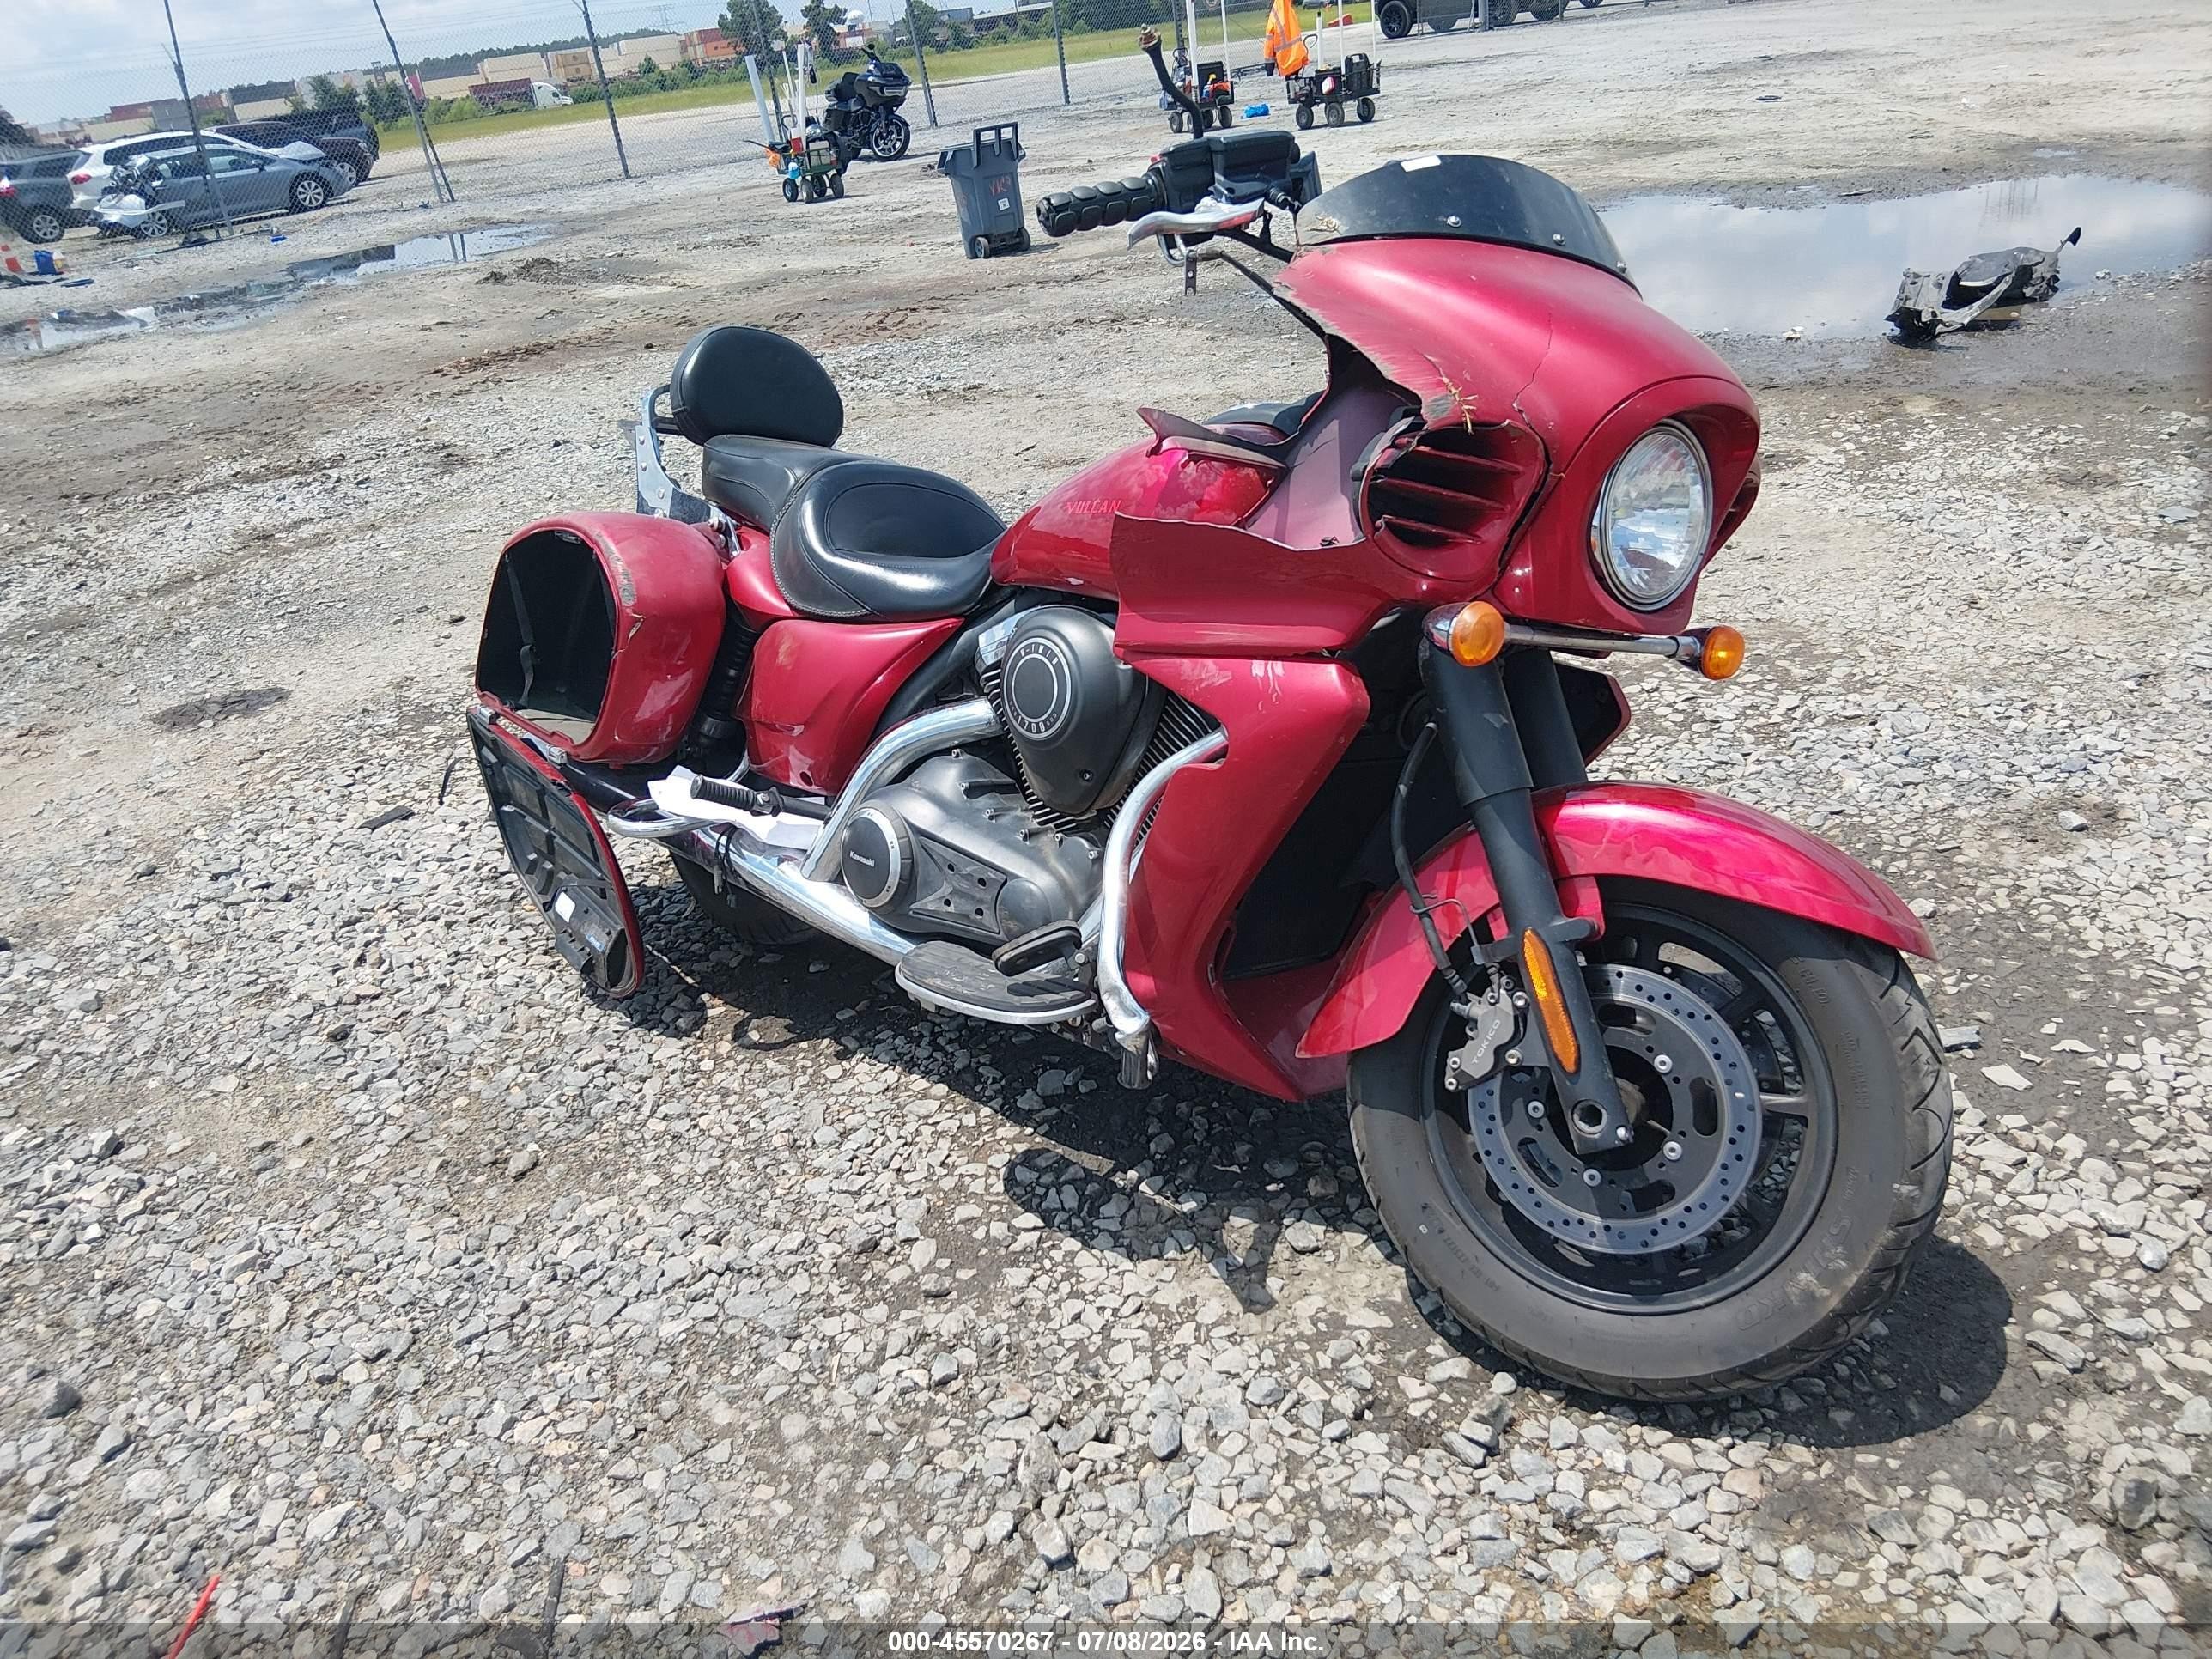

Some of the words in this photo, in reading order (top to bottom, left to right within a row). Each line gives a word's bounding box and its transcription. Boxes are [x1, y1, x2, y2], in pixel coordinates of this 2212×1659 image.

[1066, 498, 1122, 515] VULCAN
[1019, 644, 1059, 665] V-TWIN
[1017, 714, 1045, 733] 1700
[848, 850, 875, 867] Kawasaki
[1471, 1018, 1501, 1065] TOKICO
